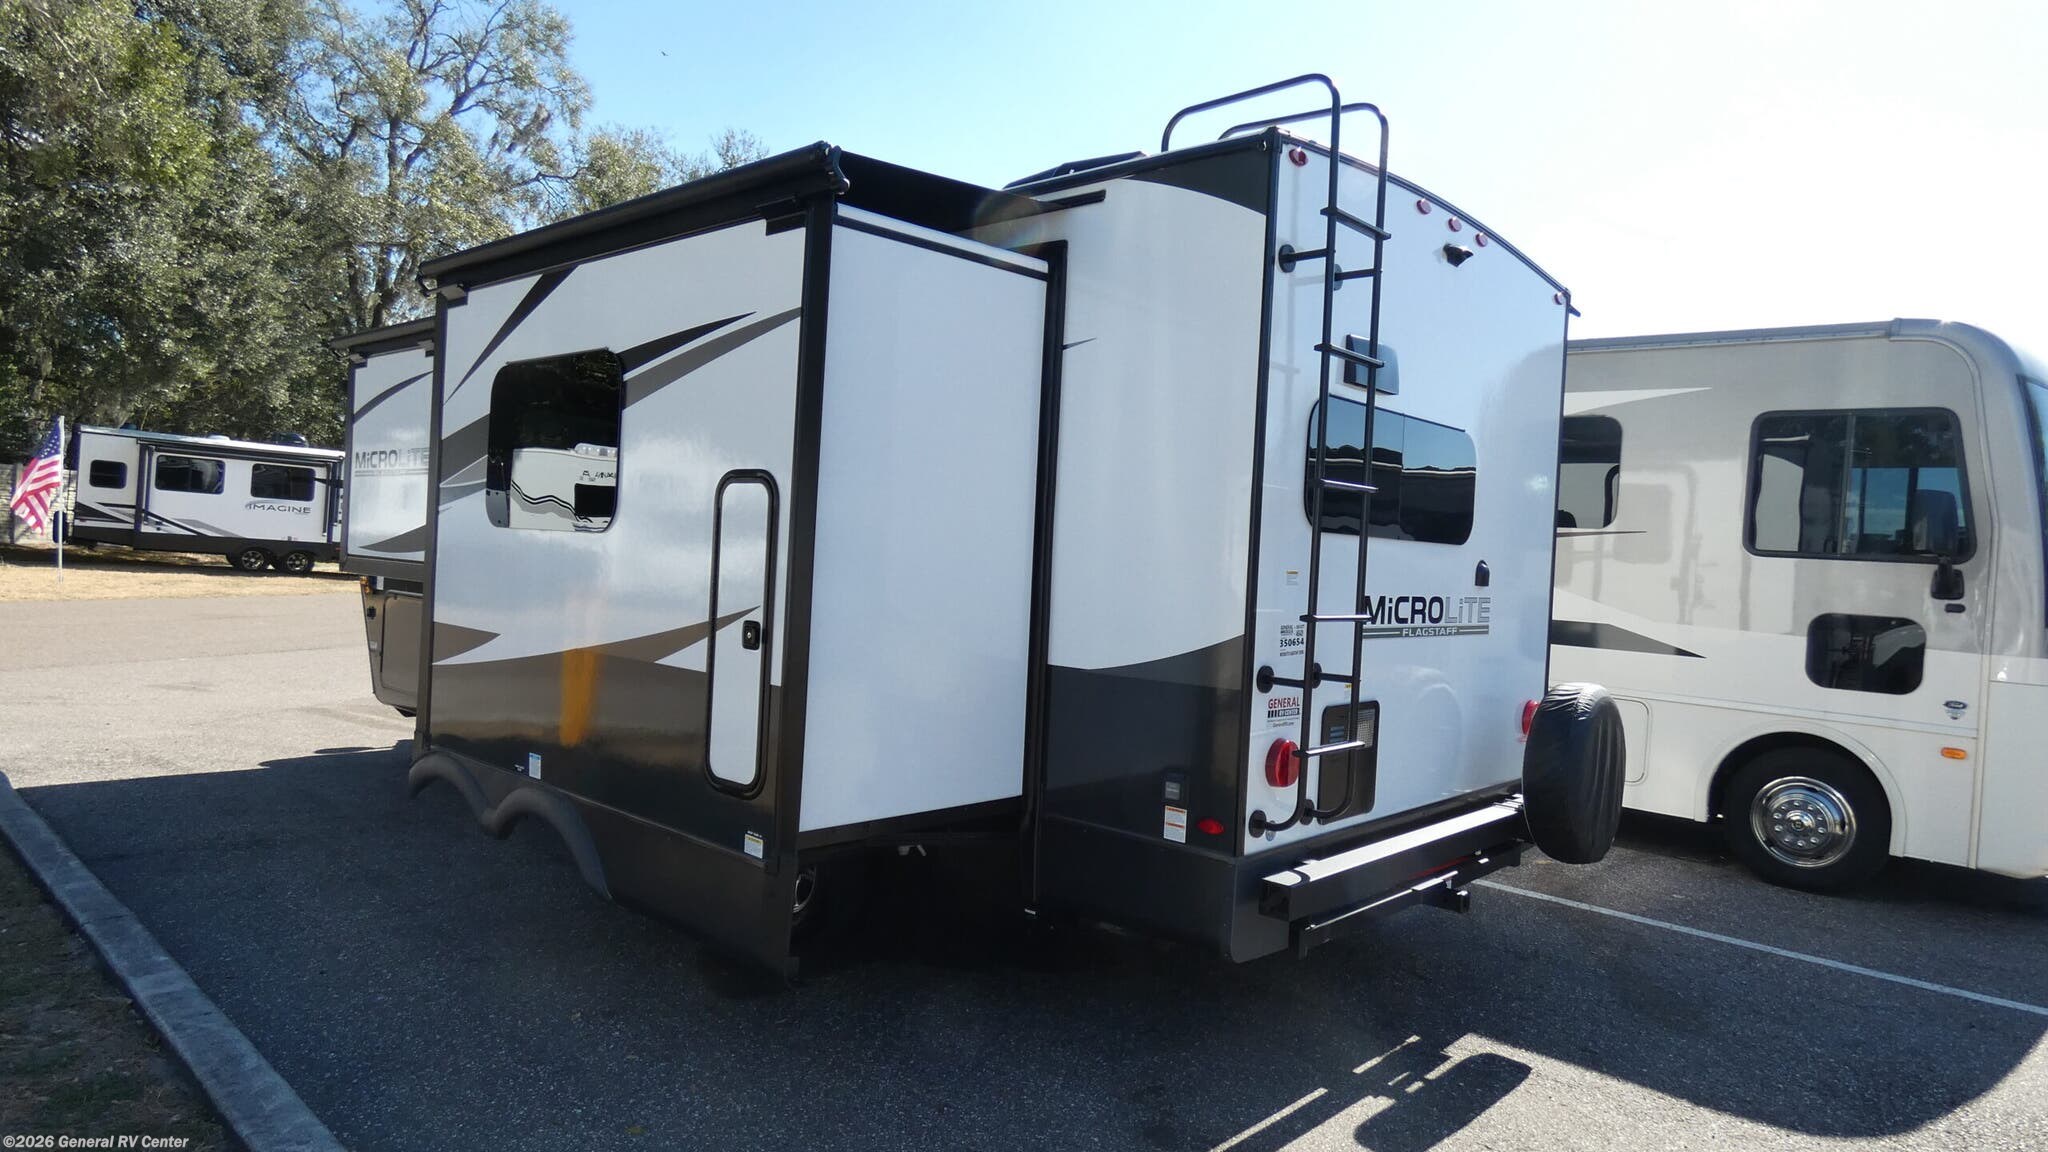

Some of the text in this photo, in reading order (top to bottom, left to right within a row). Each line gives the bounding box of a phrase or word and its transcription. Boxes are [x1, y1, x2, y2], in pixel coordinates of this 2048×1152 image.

[249, 503, 312, 514] IMAGINE
[1402, 627, 1458, 637] FLAGSTAFF
[1280, 638, 1304, 648] 350654
[1267, 696, 1300, 709] GENERAL
